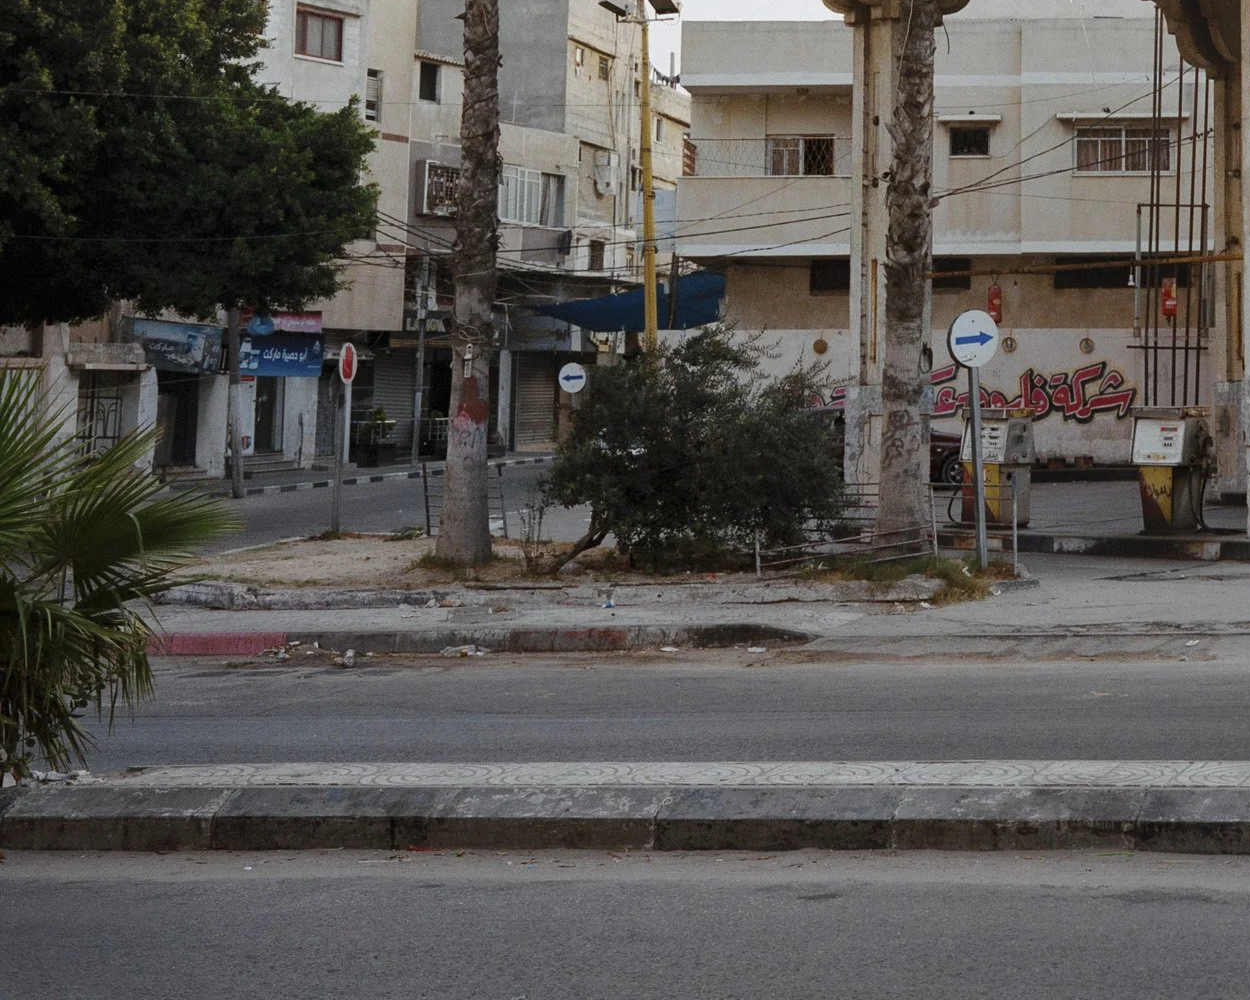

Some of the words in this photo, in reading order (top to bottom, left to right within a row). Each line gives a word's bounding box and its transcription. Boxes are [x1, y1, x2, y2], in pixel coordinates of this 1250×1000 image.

[263, 347, 281, 362] ماركت
[282, 348, 298, 362] حصيرة
[299, 347, 308, 363] أبو
[1050, 361, 1136, 423] شركة
